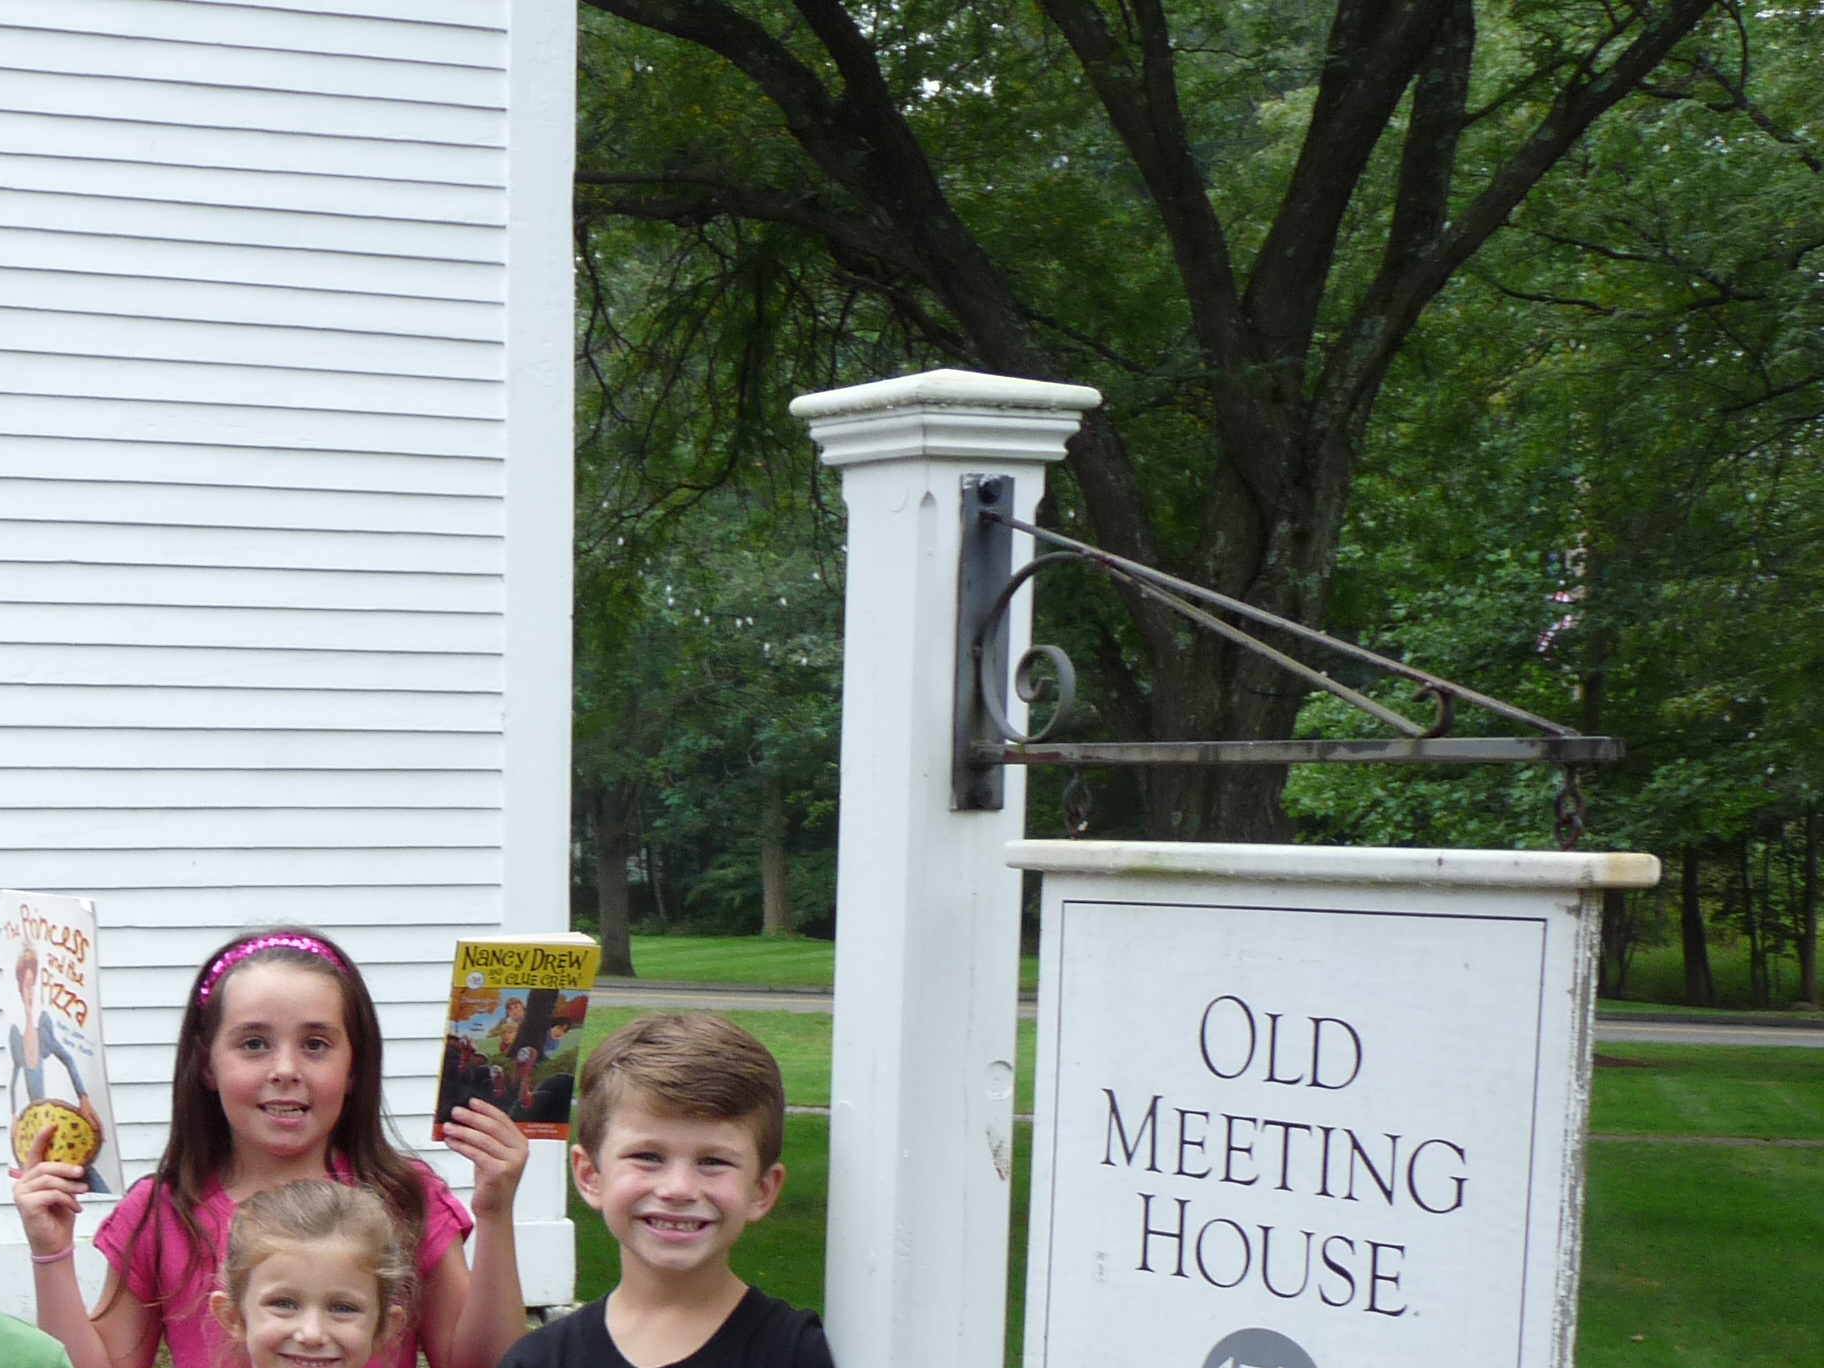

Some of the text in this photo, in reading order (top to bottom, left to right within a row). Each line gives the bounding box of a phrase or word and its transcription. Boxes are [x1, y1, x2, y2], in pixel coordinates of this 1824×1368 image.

[1198, 994, 1362, 1090] OLD
[1100, 1087, 1469, 1214] MEETING
[1135, 1192, 1408, 1317] HOUSE
